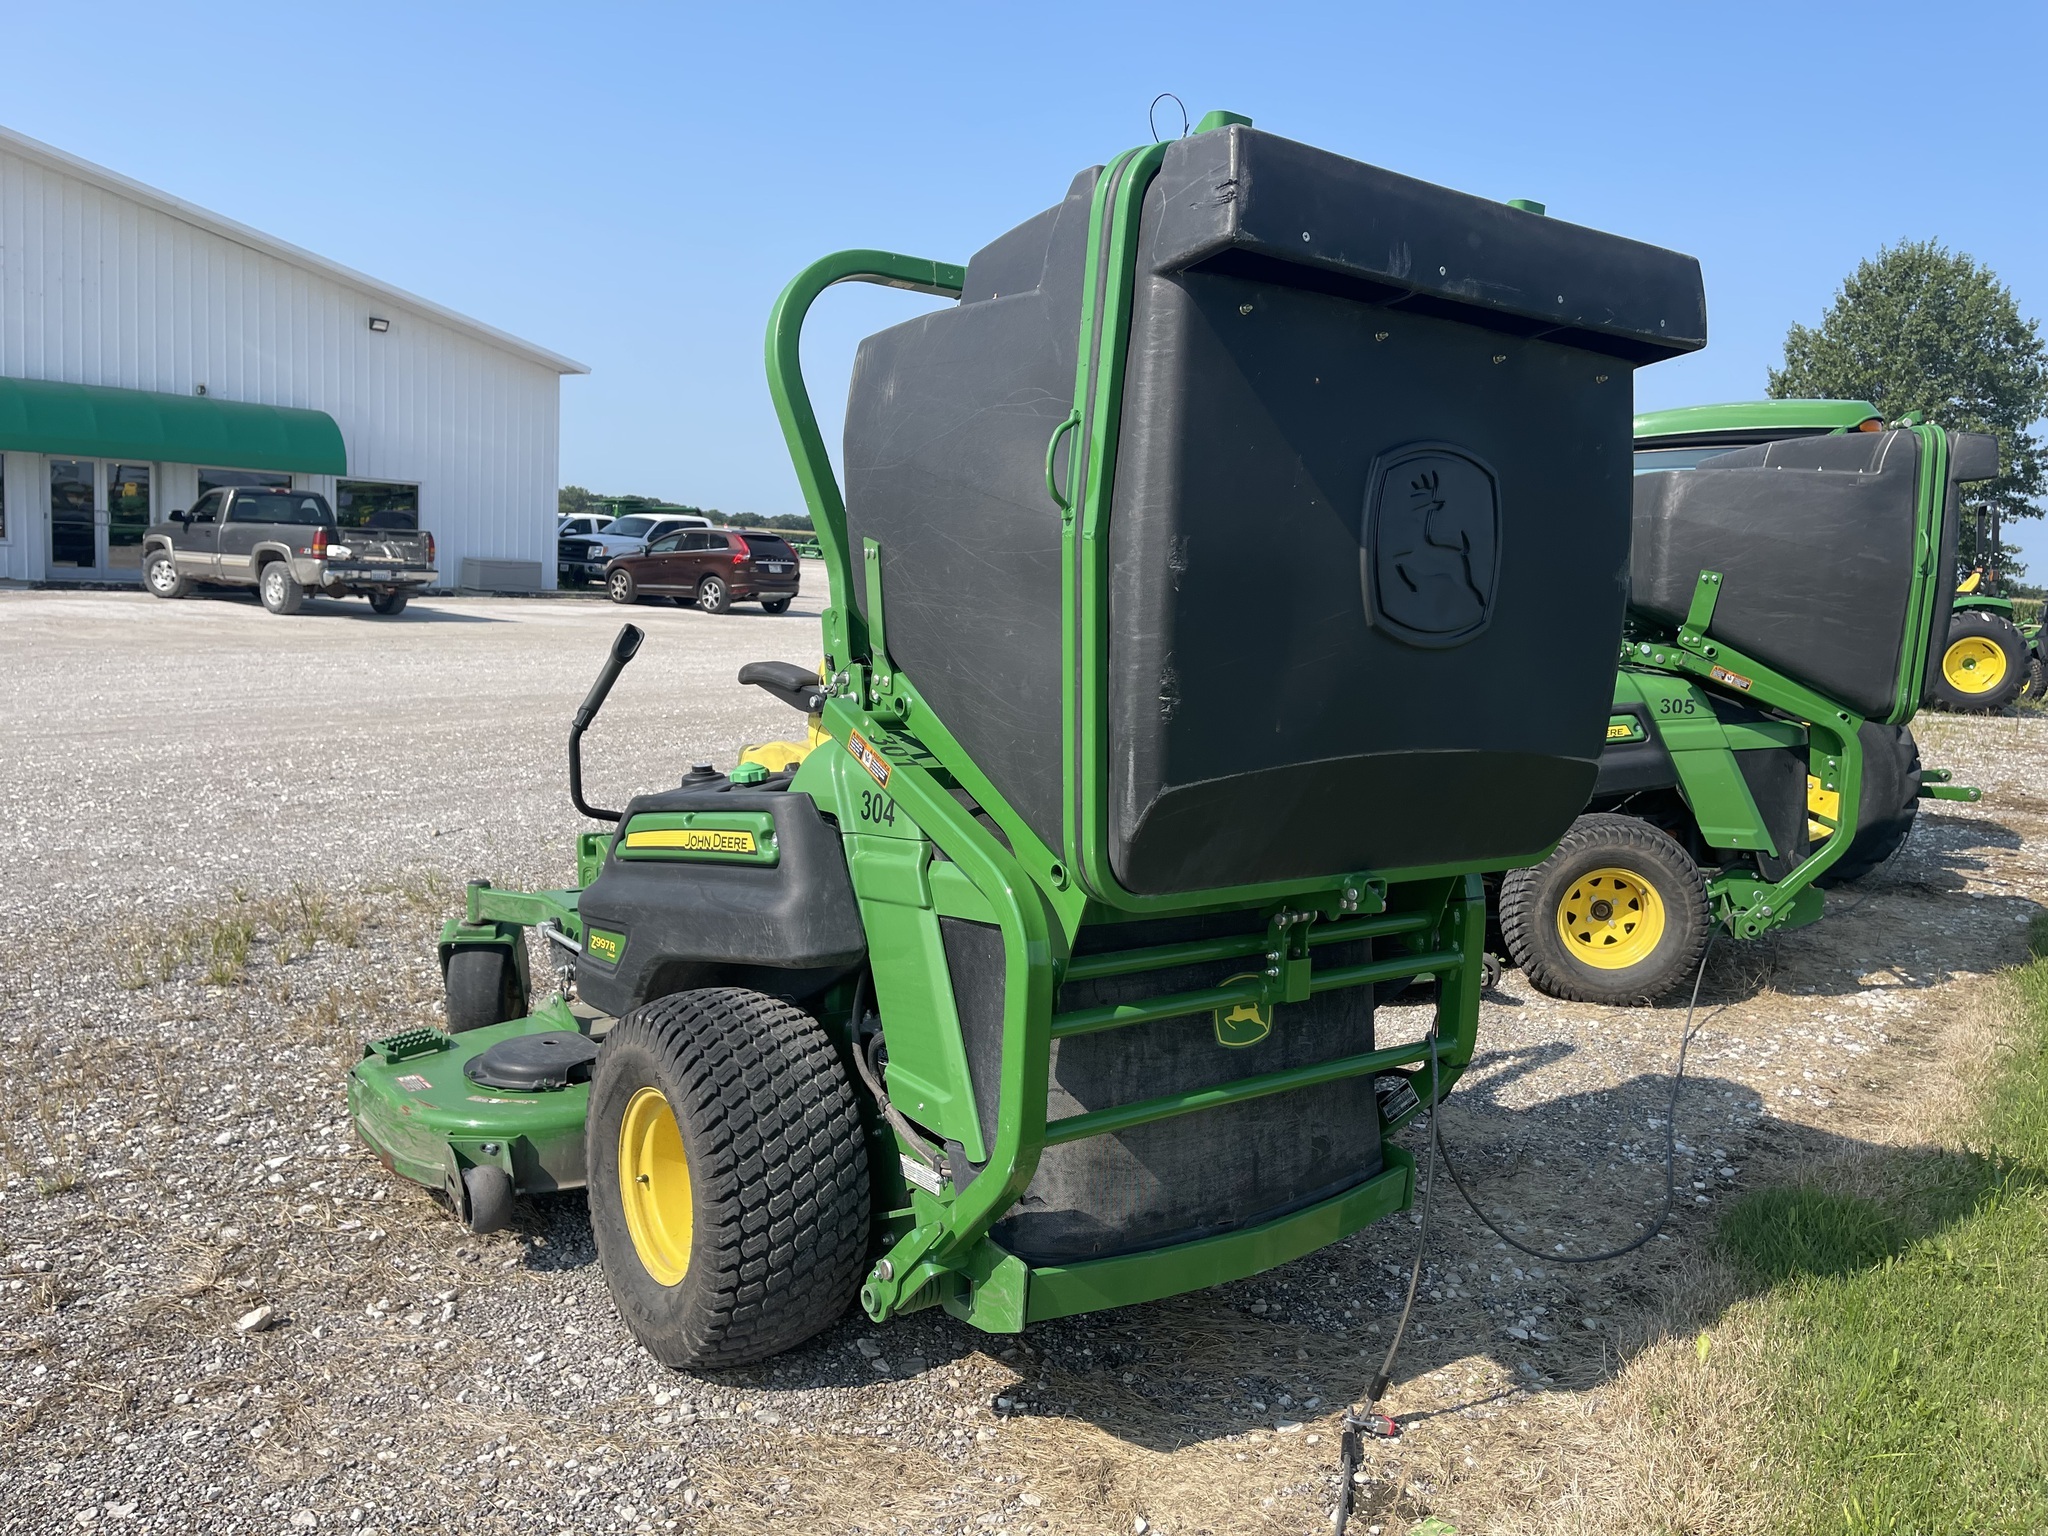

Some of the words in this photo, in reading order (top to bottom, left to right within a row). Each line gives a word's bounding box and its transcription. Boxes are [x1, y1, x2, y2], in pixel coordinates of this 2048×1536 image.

[1660, 698, 1695, 715] 305
[860, 789, 895, 827] 304
[684, 832, 711, 848] JOHN
[713, 833, 748, 849] DEERE
[590, 934, 616, 952] Z997R
